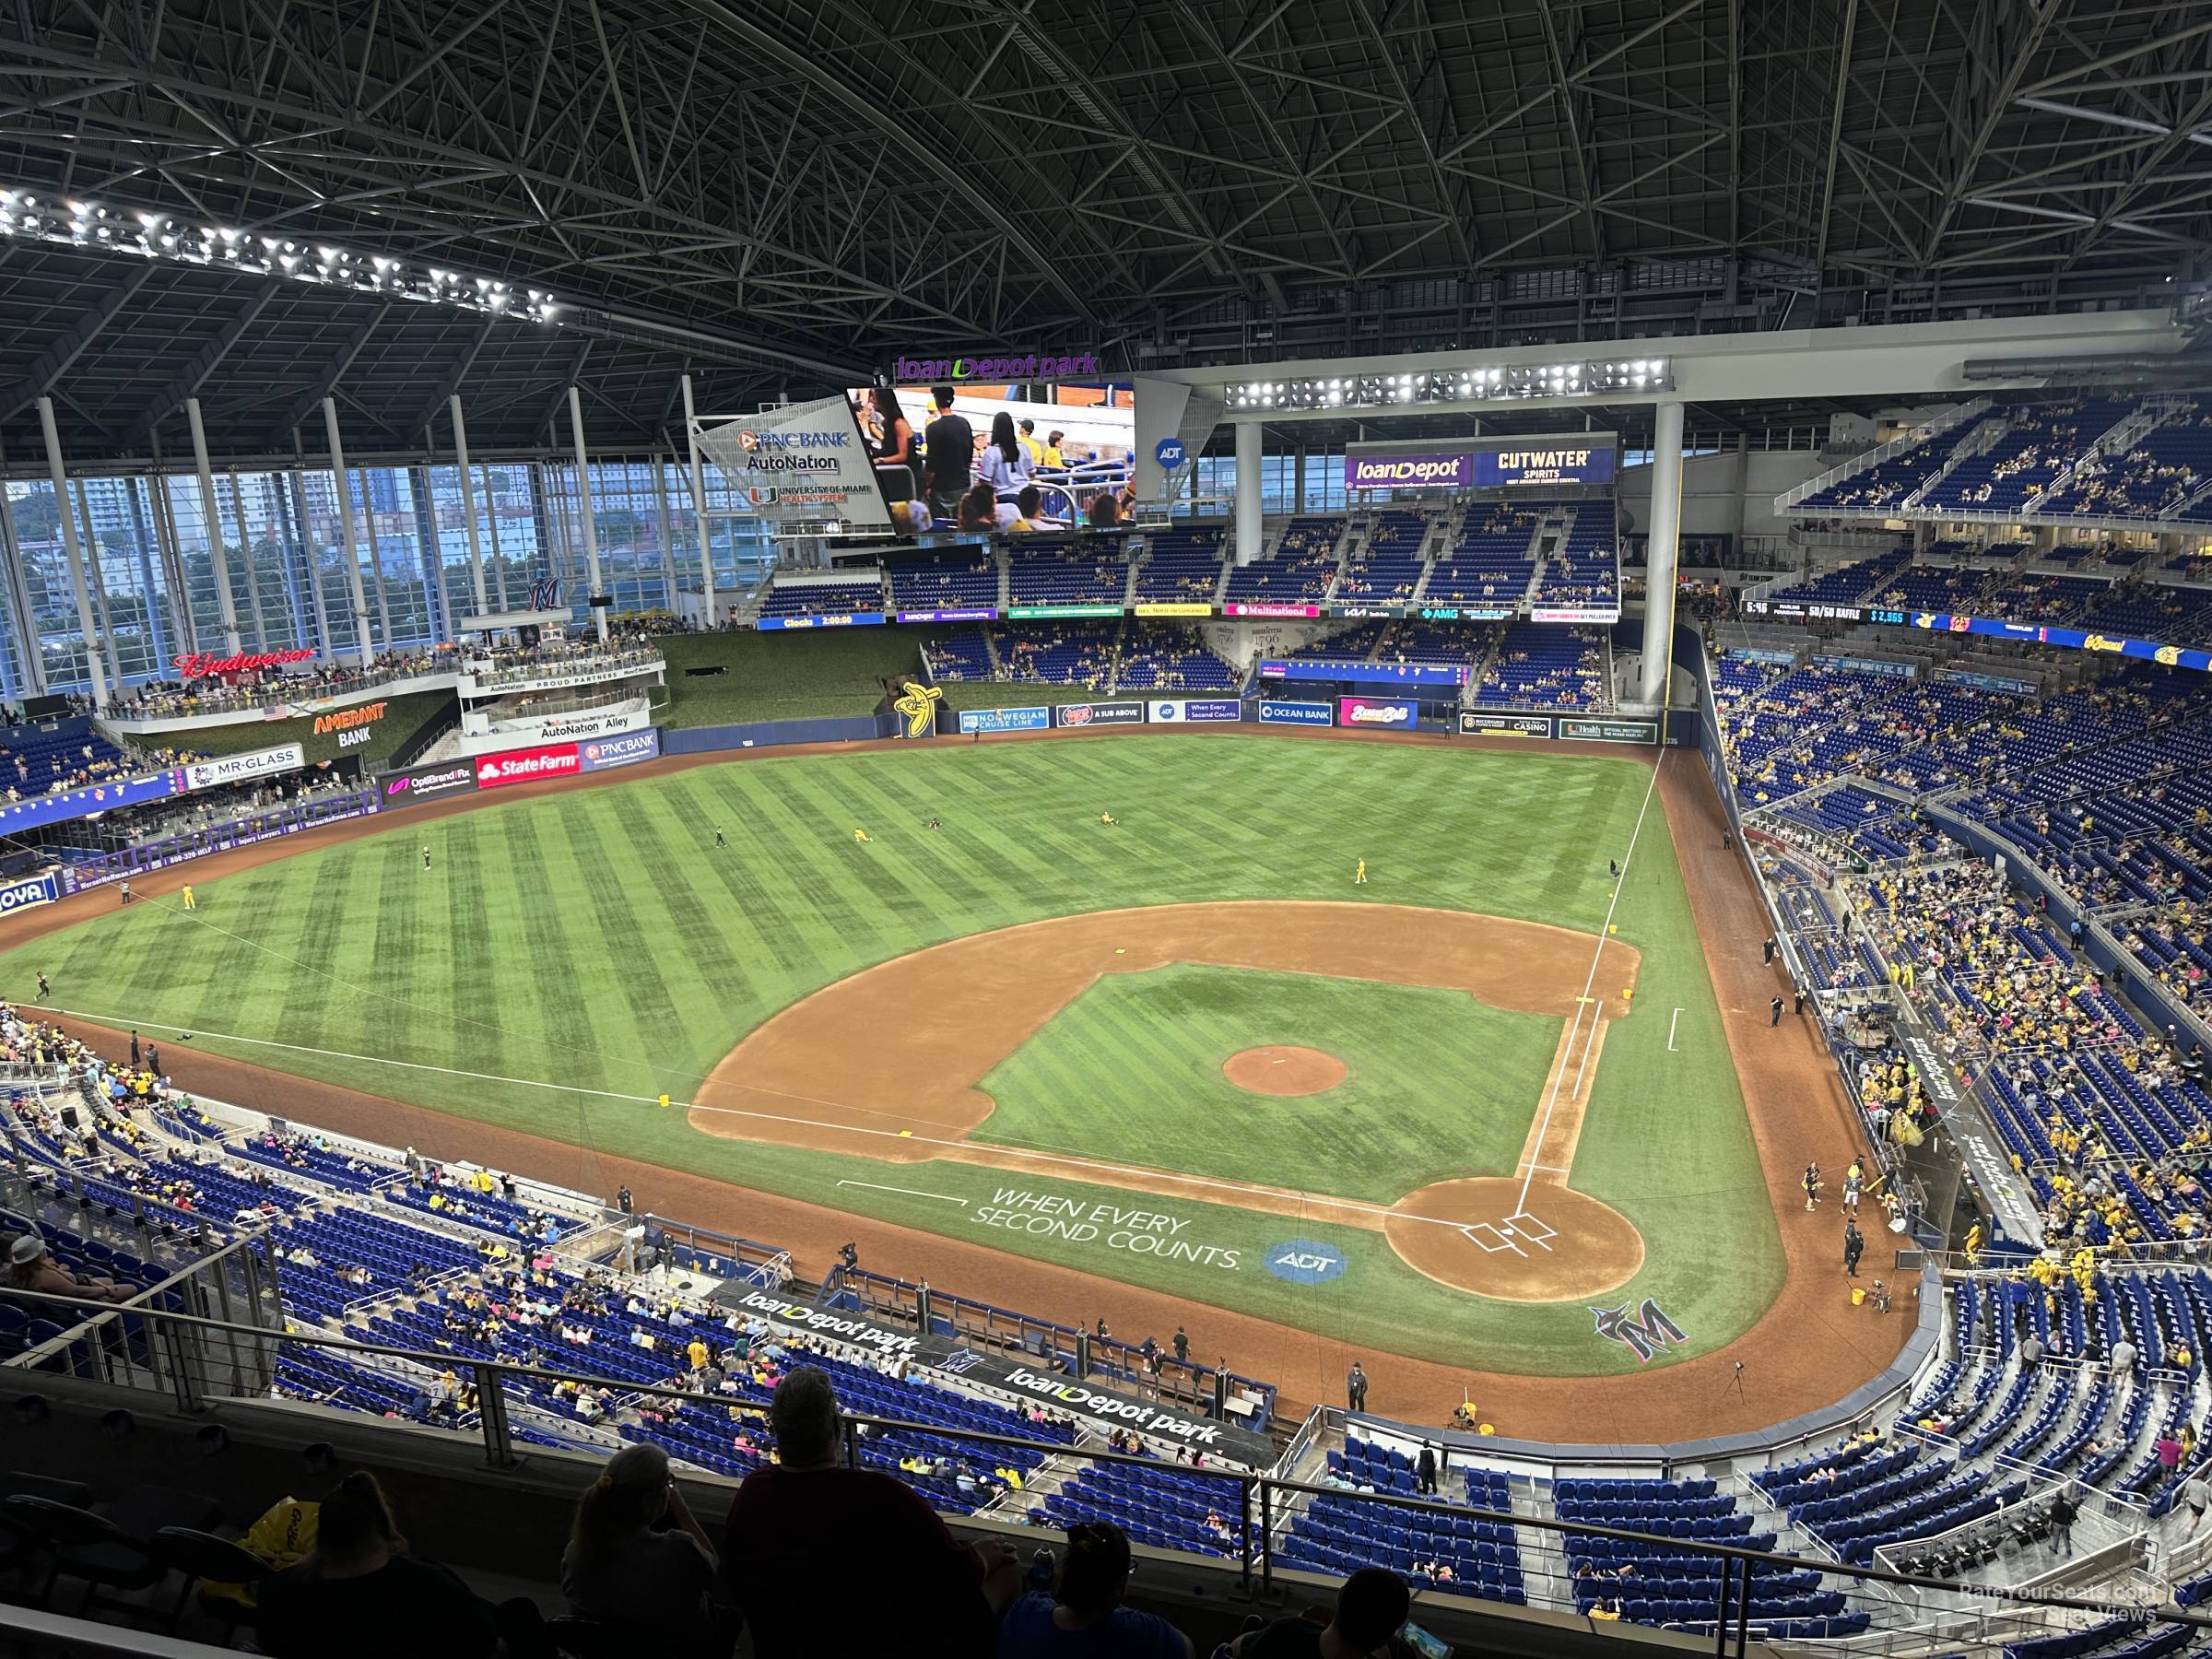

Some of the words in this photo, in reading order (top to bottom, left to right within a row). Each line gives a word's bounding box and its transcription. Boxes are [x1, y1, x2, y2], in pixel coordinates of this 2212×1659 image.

[898, 354, 1036, 382] loanDepot
[1040, 352, 1099, 380] park
[1160, 448, 1182, 459] ADT
[1499, 451, 1587, 468] CUTWATER
[747, 455, 837, 471] AutoNation
[1357, 458, 1459, 480] loanDepot
[1524, 469, 1559, 478] SPIRITS
[779, 487, 829, 495] UNIVERSITY
[830, 486, 841, 494] OF
[842, 485, 871, 494] MIAMI
[780, 495, 812, 503] HEALTH
[1249, 606, 1307, 616] Multinational
[1433, 609, 1458, 618] AMG
[1747, 602, 1768, 613] 5:46
[1809, 606, 1834, 618] 50/50
[1836, 608, 1860, 619] RAFFLE
[1871, 610, 1877, 621] $
[822, 616, 852, 625] 2:00:00
[1254, 635, 1279, 647] 1796
[174, 648, 317, 679] Budweiser
[1842, 660, 1860, 668] LEARN
[1861, 662, 1874, 670] MORE
[1897, 666, 1903, 675] 15
[490, 683, 525, 692] AutoNation
[536, 679, 570, 688] PROUD
[574, 673, 618, 684] PARTNERS
[313, 702, 385, 735] AMERANT
[1274, 710, 1303, 718] OCEAN
[1305, 711, 1329, 719] BANK
[541, 723, 599, 738] AutoNation
[606, 717, 628, 728] Alley
[1513, 723, 1547, 731] CASINO
[338, 727, 371, 747] BANK
[171, 846, 212, 863] 800-320-HELP
[239, 835, 256, 845] Injury
[258, 830, 281, 840] Lawyers
[80, 866, 143, 889] WernerHoffman.com
[0, 884, 42, 912] OYA
[992, 1187, 1087, 1218] WHEN
[1088, 1205, 1192, 1236] EVERY
[970, 1206, 1098, 1242] SECOND
[1107, 1230, 1241, 1271] COUNTS.
[1275, 1252, 1337, 1274] ADT
[738, 1291, 866, 1335] loanDepot
[853, 1327, 921, 1352] park
[1004, 1368, 1155, 1423] loanDepot
[1147, 1414, 1223, 1443] park
